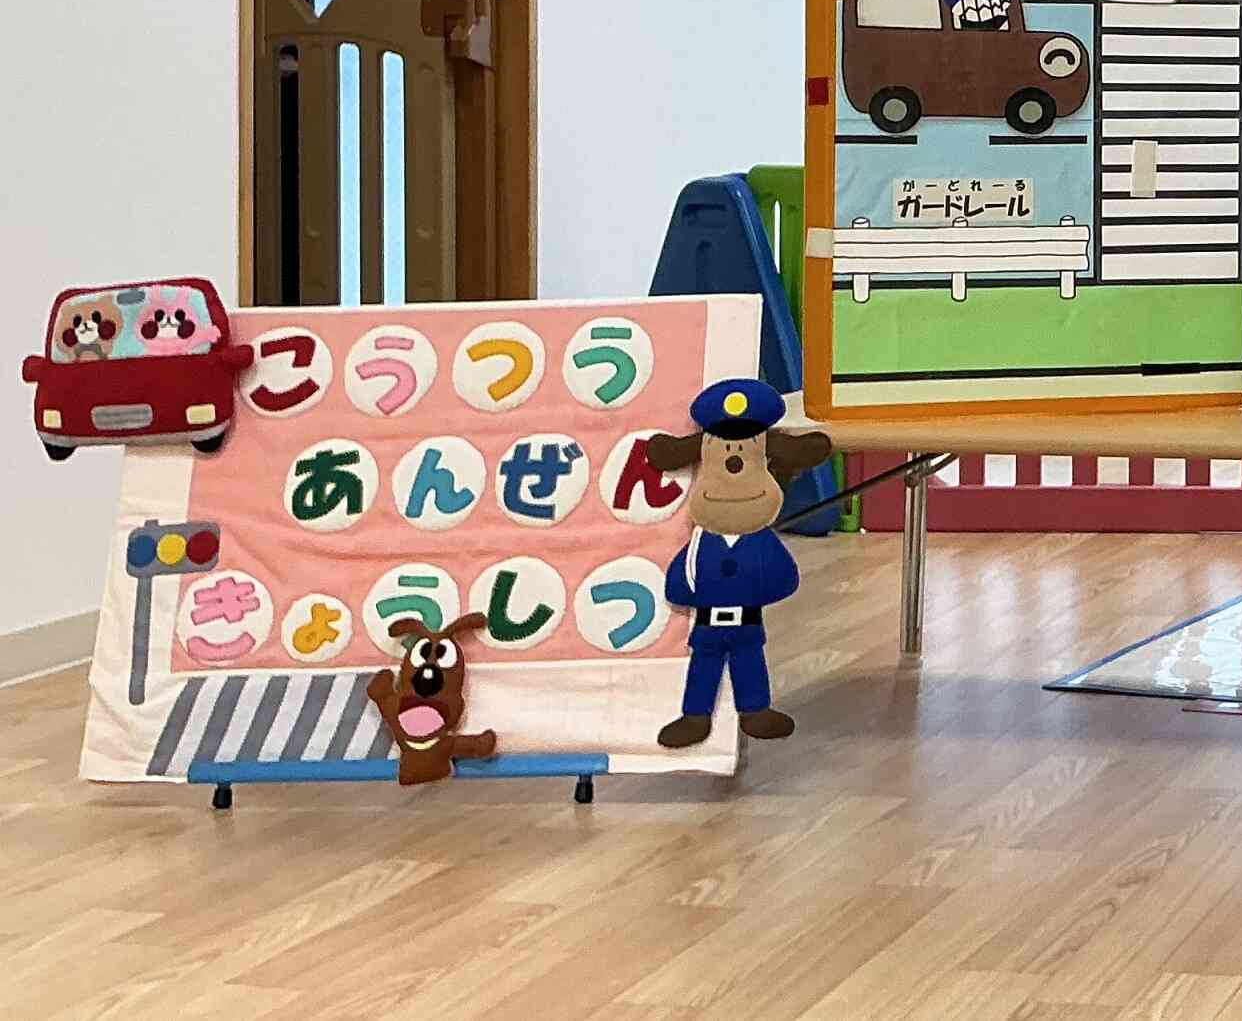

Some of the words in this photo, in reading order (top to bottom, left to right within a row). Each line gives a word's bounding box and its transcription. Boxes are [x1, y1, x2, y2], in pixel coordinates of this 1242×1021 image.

[897, 194, 1031, 218] ガードレール
[902, 179, 1026, 193] がーどれーる
[250, 325, 638, 416] こうつう
[291, 438, 683, 521] あんぜん
[186, 570, 656, 660] きょうしつ
